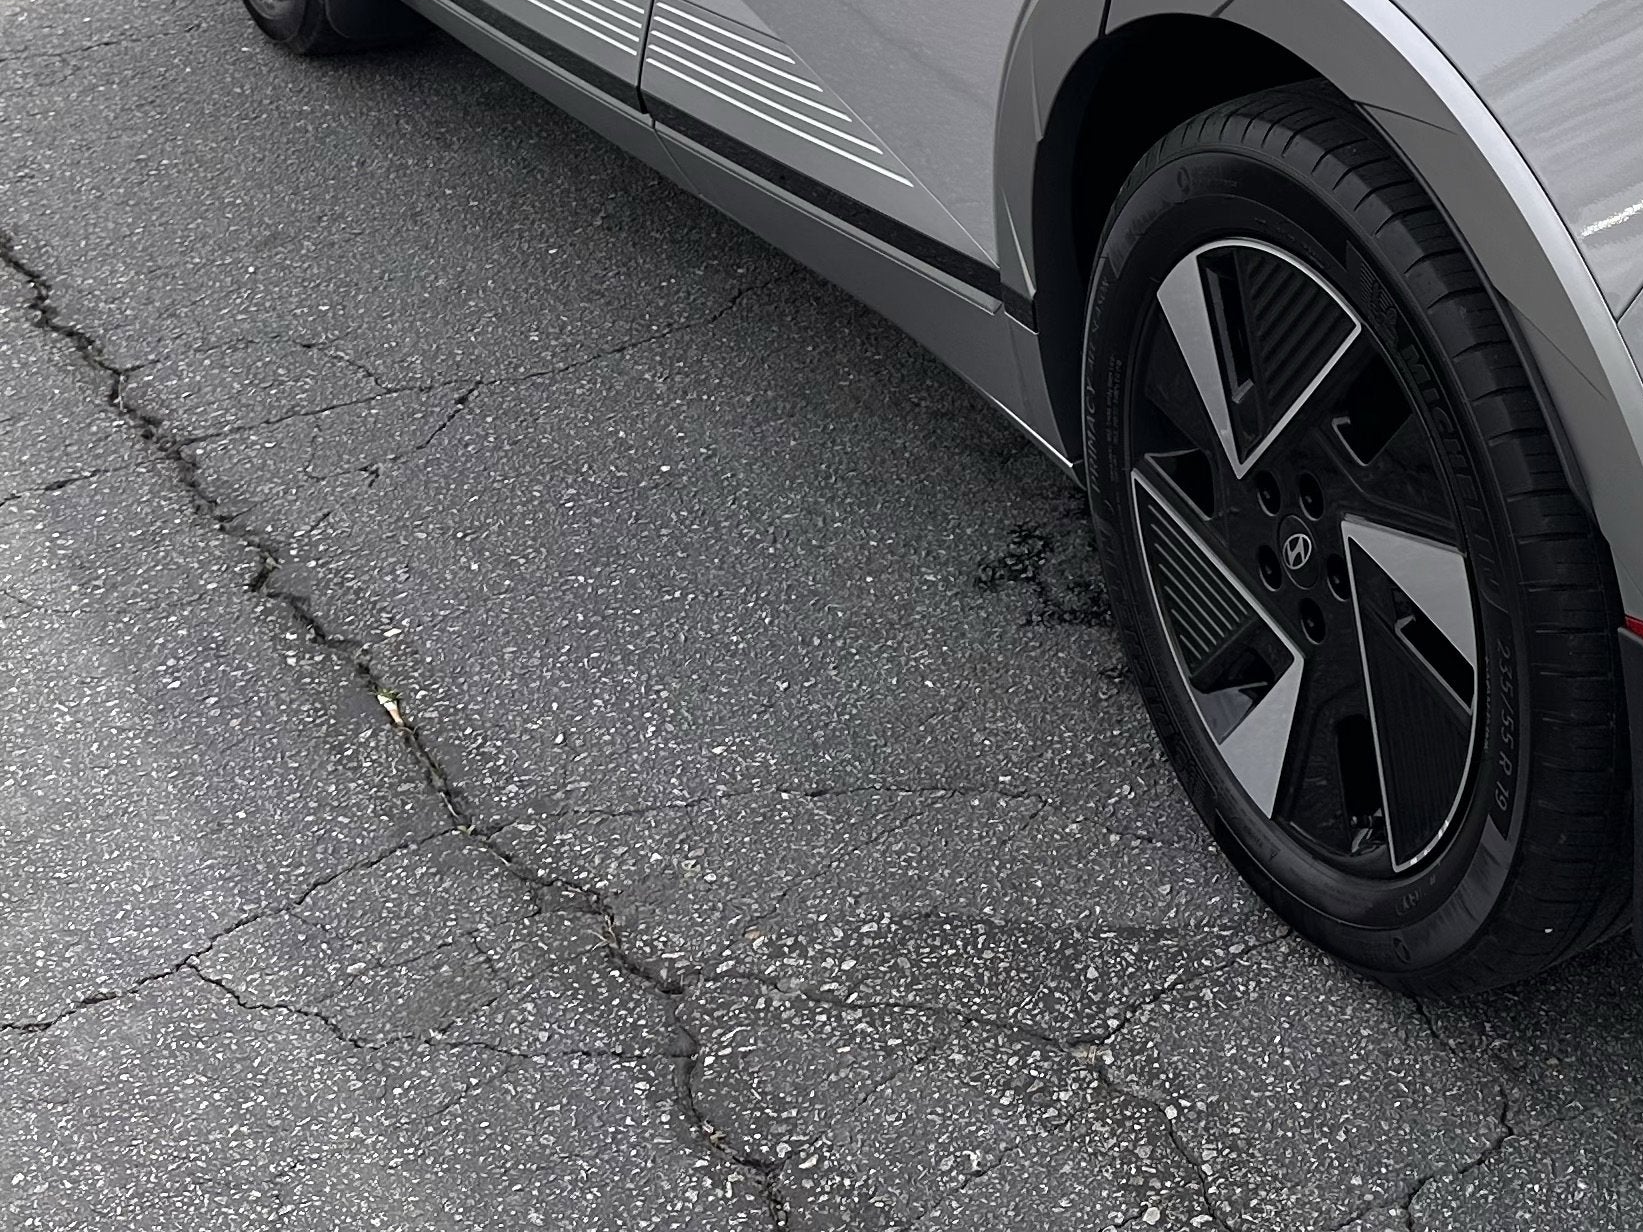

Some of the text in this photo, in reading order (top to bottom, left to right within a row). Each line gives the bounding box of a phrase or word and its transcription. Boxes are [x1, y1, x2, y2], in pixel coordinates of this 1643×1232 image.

[1086, 376, 1101, 493] PRIMACY
[1496, 638, 1514, 811] 235/55 R 19
